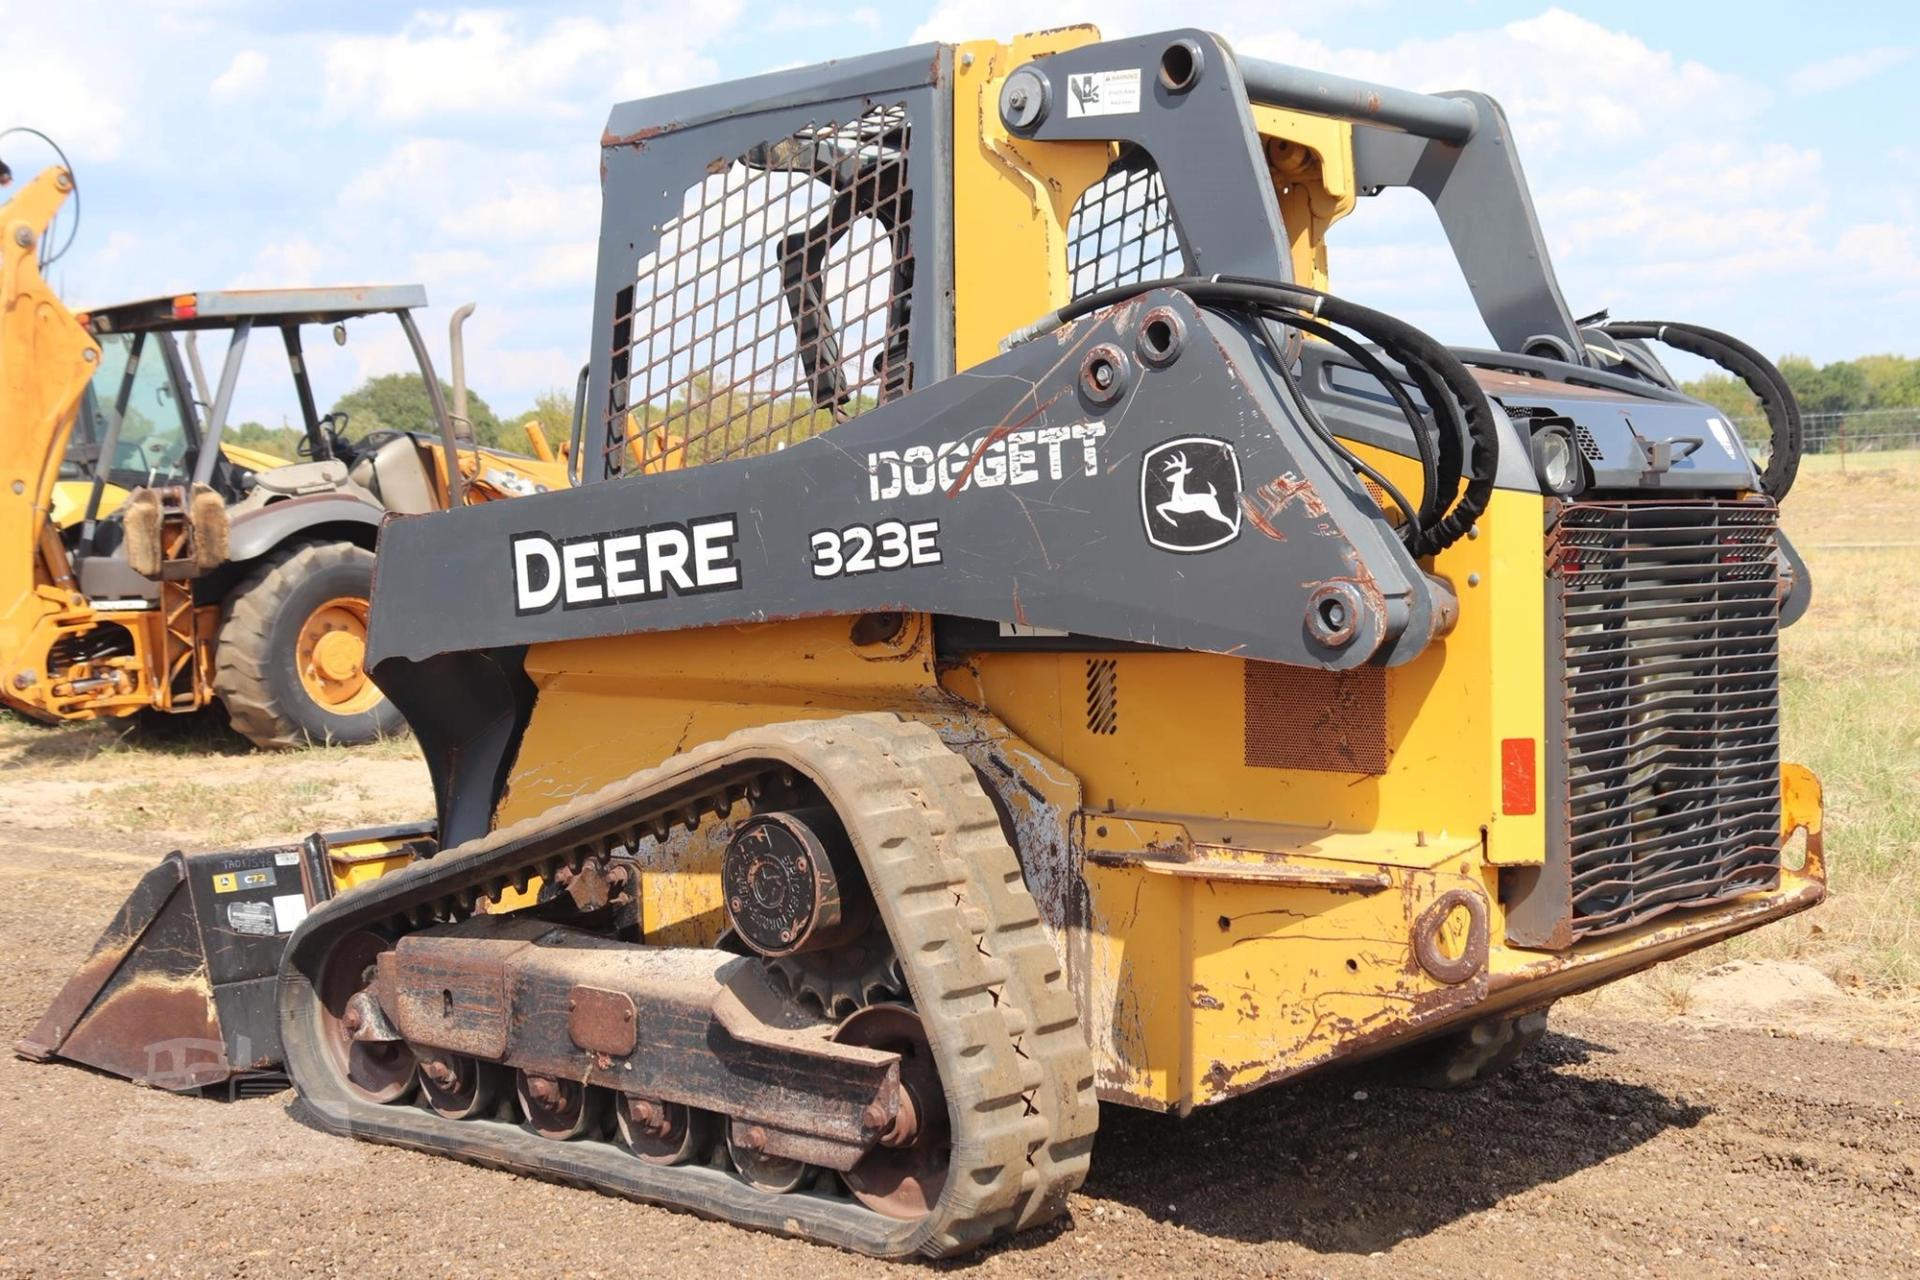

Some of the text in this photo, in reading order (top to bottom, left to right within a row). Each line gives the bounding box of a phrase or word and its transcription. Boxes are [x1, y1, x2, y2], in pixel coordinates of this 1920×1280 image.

[867, 421, 1106, 501] DOGGETT
[513, 519, 739, 610] DEERE
[810, 520, 942, 579] 323E
[244, 874, 266, 884] C72
